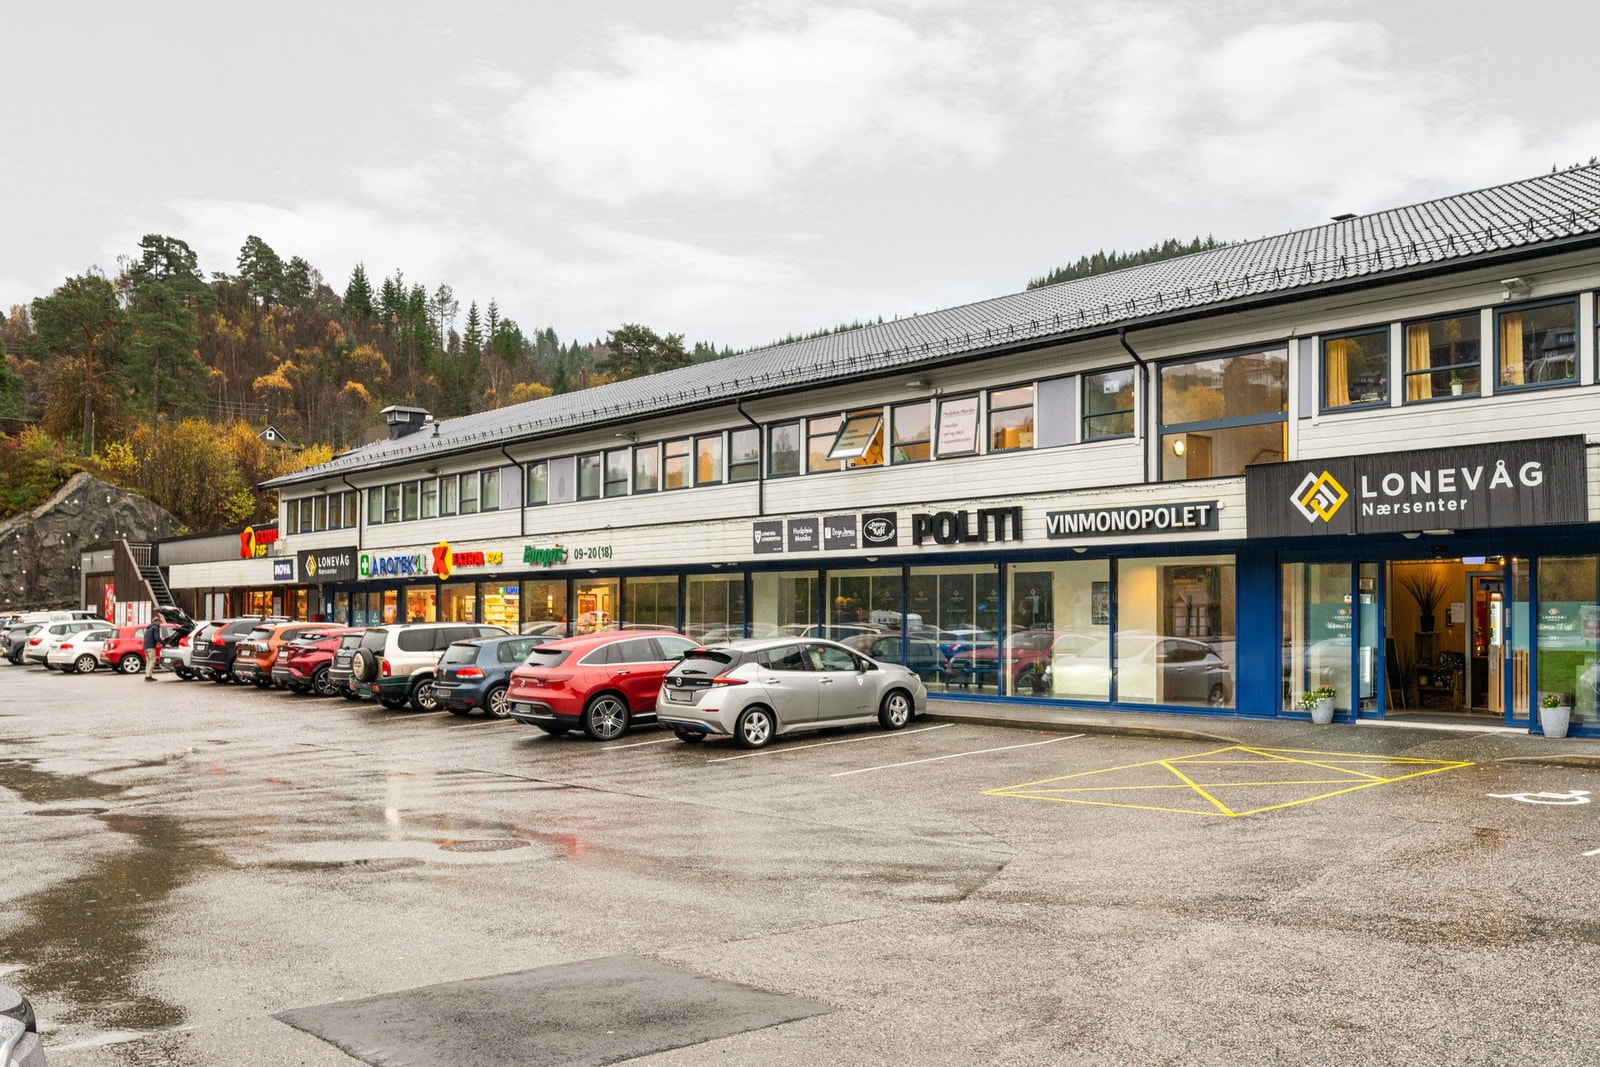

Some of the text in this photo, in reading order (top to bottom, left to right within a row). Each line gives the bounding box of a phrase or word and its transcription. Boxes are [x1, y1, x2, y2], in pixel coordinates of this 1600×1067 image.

[1362, 460, 1543, 498] LONEVÅG
[1362, 499, 1468, 516] Nærsenter
[912, 506, 1023, 546] POLITI
[1046, 505, 1210, 534] VINMONOPOLET
[318, 553, 350, 568] LONEVÅG
[372, 555, 415, 575] APOTEK
[452, 551, 485, 567] EXTRA
[523, 543, 564, 568] Europris
